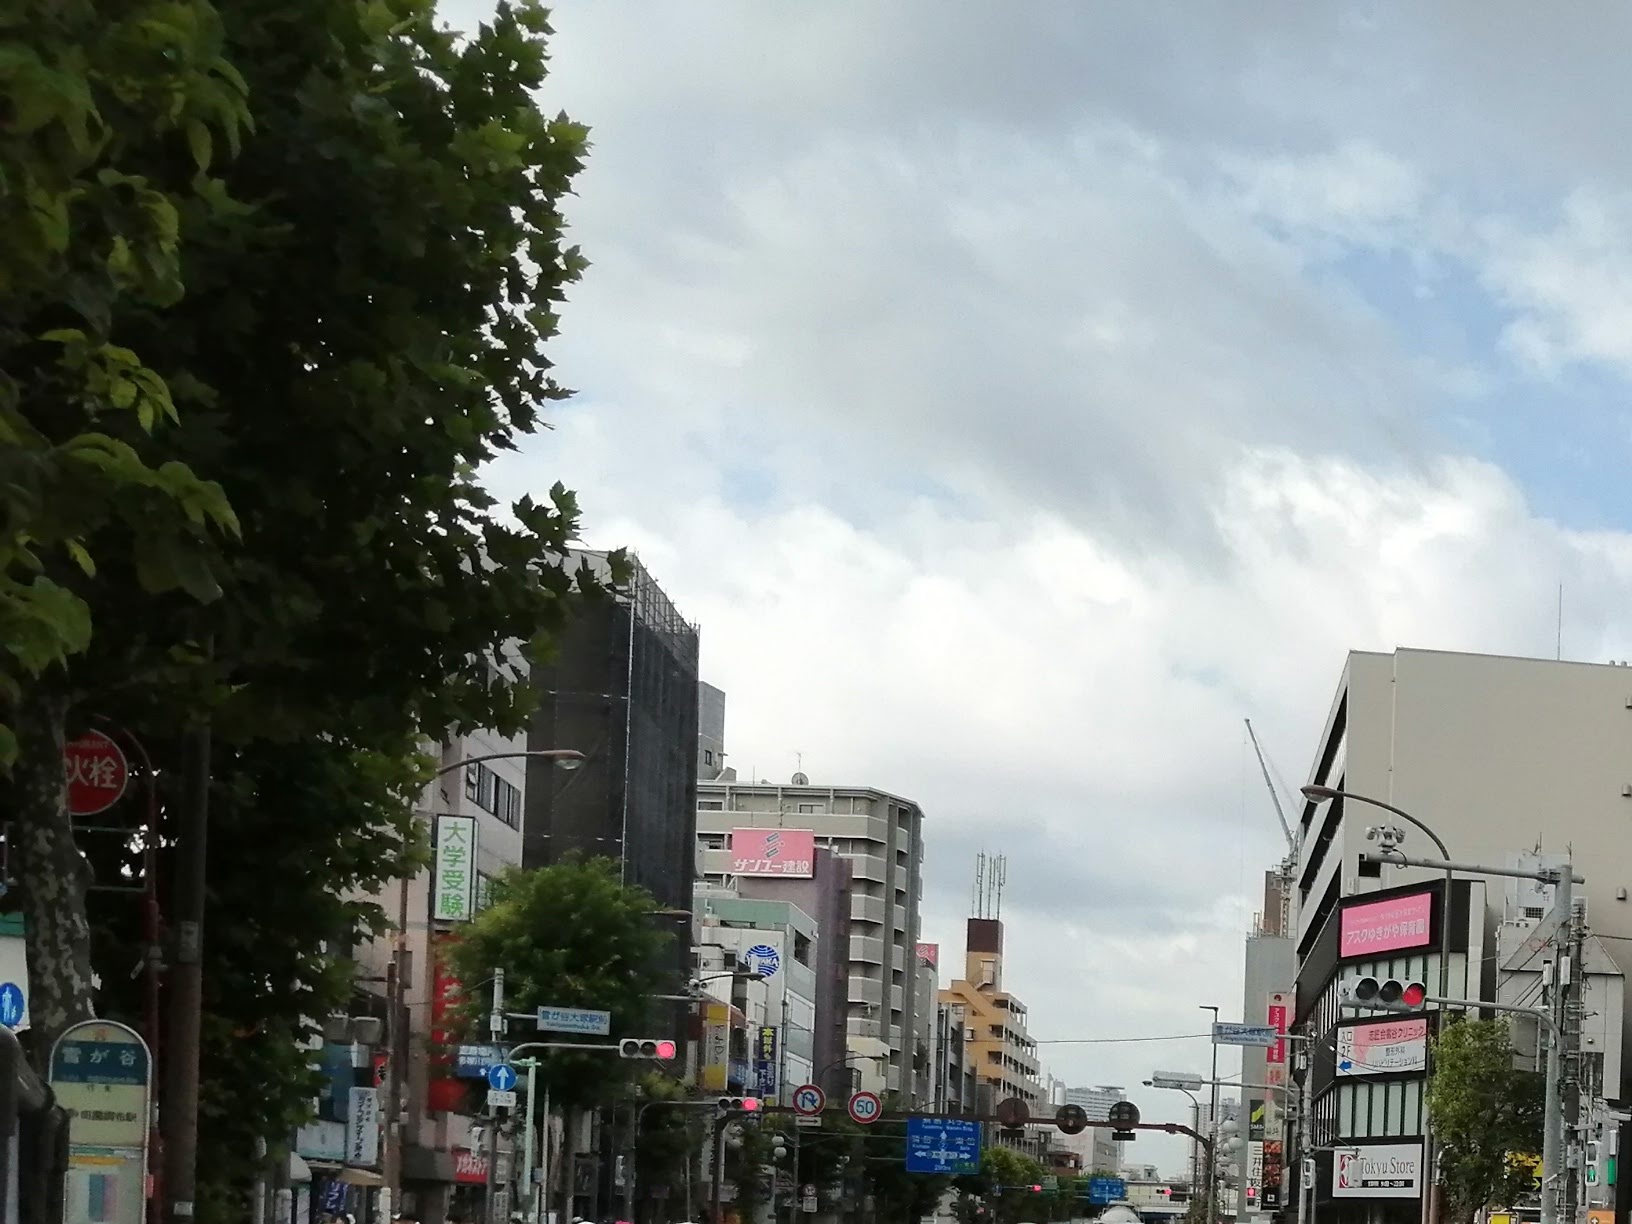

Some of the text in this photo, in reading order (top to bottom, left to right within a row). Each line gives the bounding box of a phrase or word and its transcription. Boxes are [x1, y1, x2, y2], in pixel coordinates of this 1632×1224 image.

[441, 821, 467, 918] 大学受験
[733, 858, 810, 874] サンユー建設
[1346, 918, 1425, 945] アスクゆきがや保育園
[62, 1047, 137, 1067] 雪が谷
[1341, 1045, 1351, 1058] 2F
[855, 1100, 875, 1115] 50
[1360, 1156, 1415, 1176] Tokyu Store
